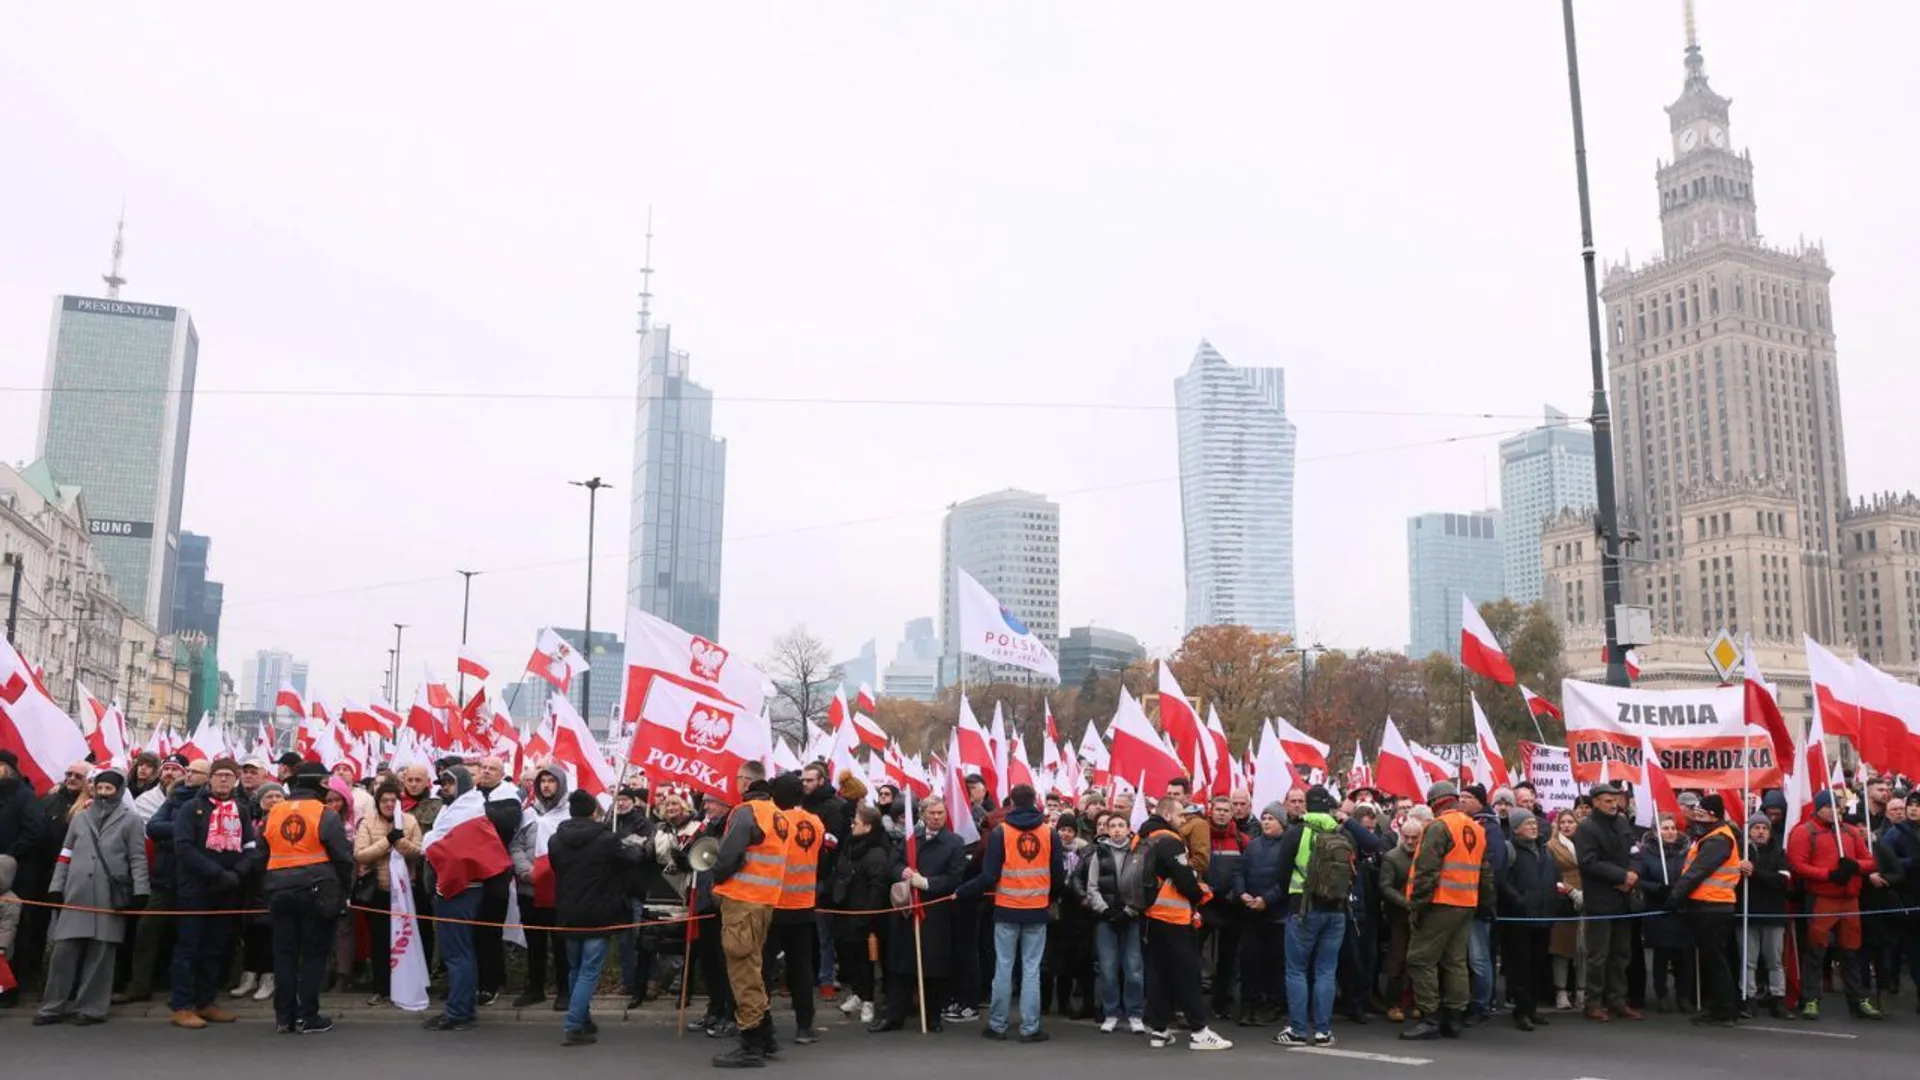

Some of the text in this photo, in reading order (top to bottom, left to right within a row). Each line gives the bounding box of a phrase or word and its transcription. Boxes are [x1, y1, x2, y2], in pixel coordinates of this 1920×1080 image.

[77, 300, 162, 317] PRESIDENTIAL
[1617, 702, 1718, 726] ZIEMIA
[1660, 748, 1773, 769] SIERADZKA
[644, 747, 728, 793] POLSKA
